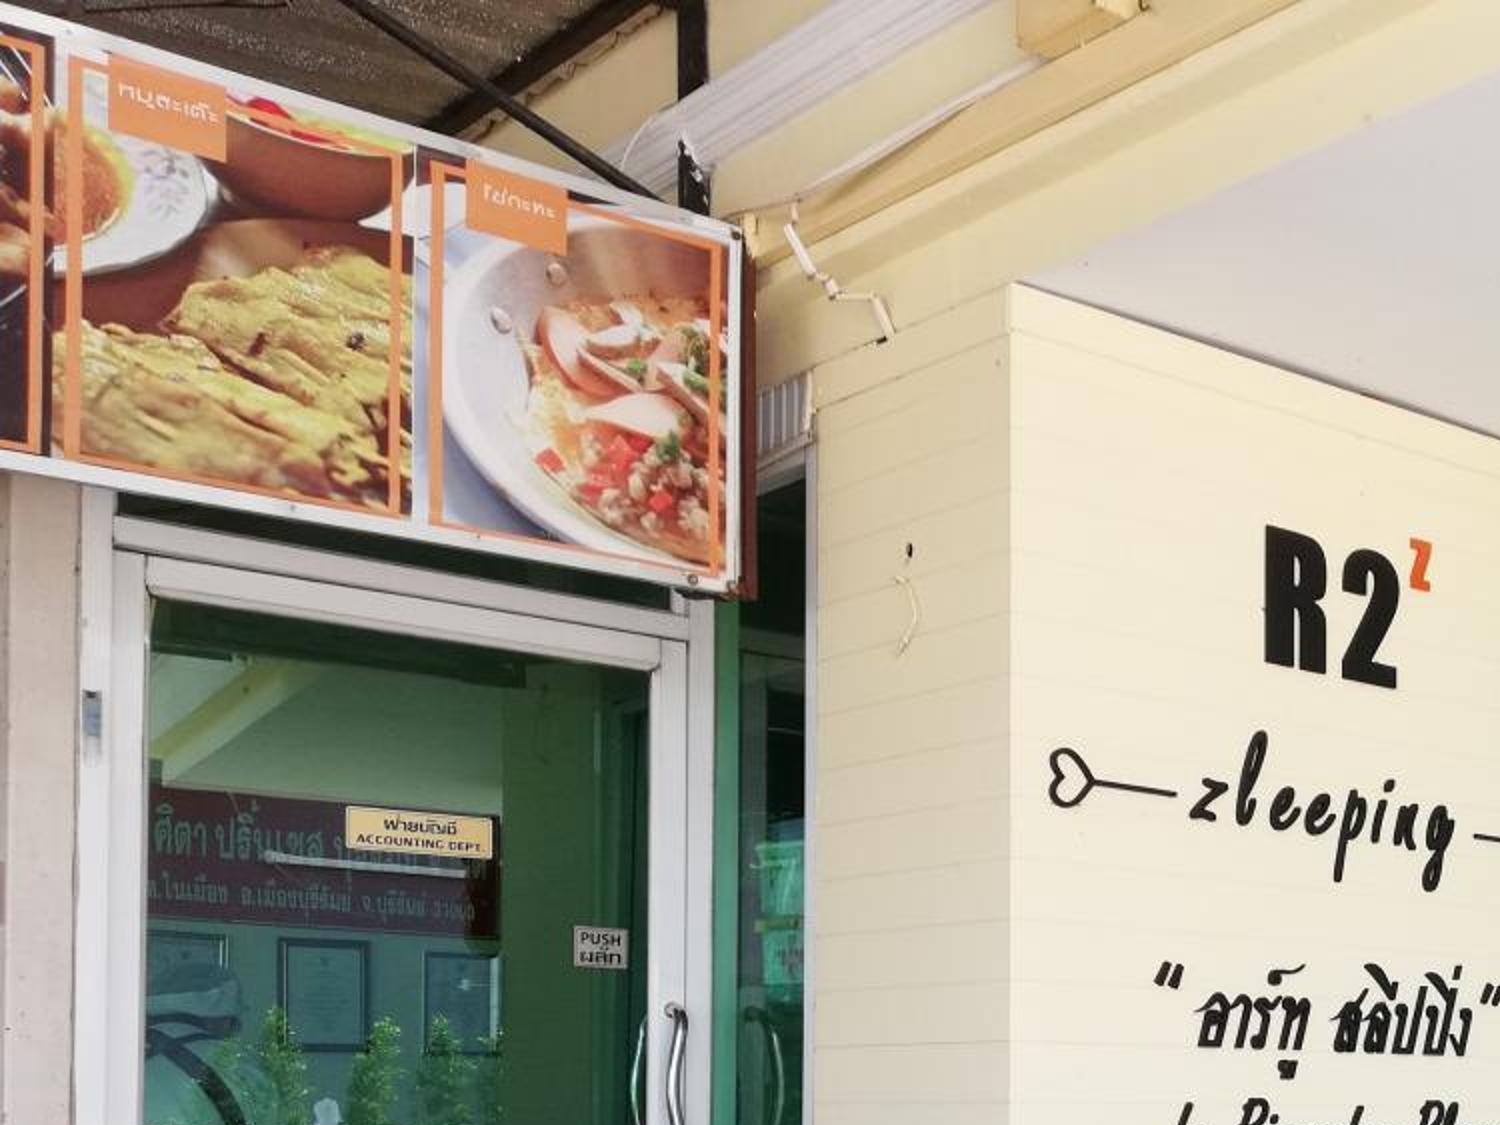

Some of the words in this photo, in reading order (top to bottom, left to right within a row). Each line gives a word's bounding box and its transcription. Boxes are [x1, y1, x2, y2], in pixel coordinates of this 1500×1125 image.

[1189, 729, 1456, 893] zleeping
[355, 833, 445, 851] ACCOUNTING
[580, 931, 621, 947] PUSH
